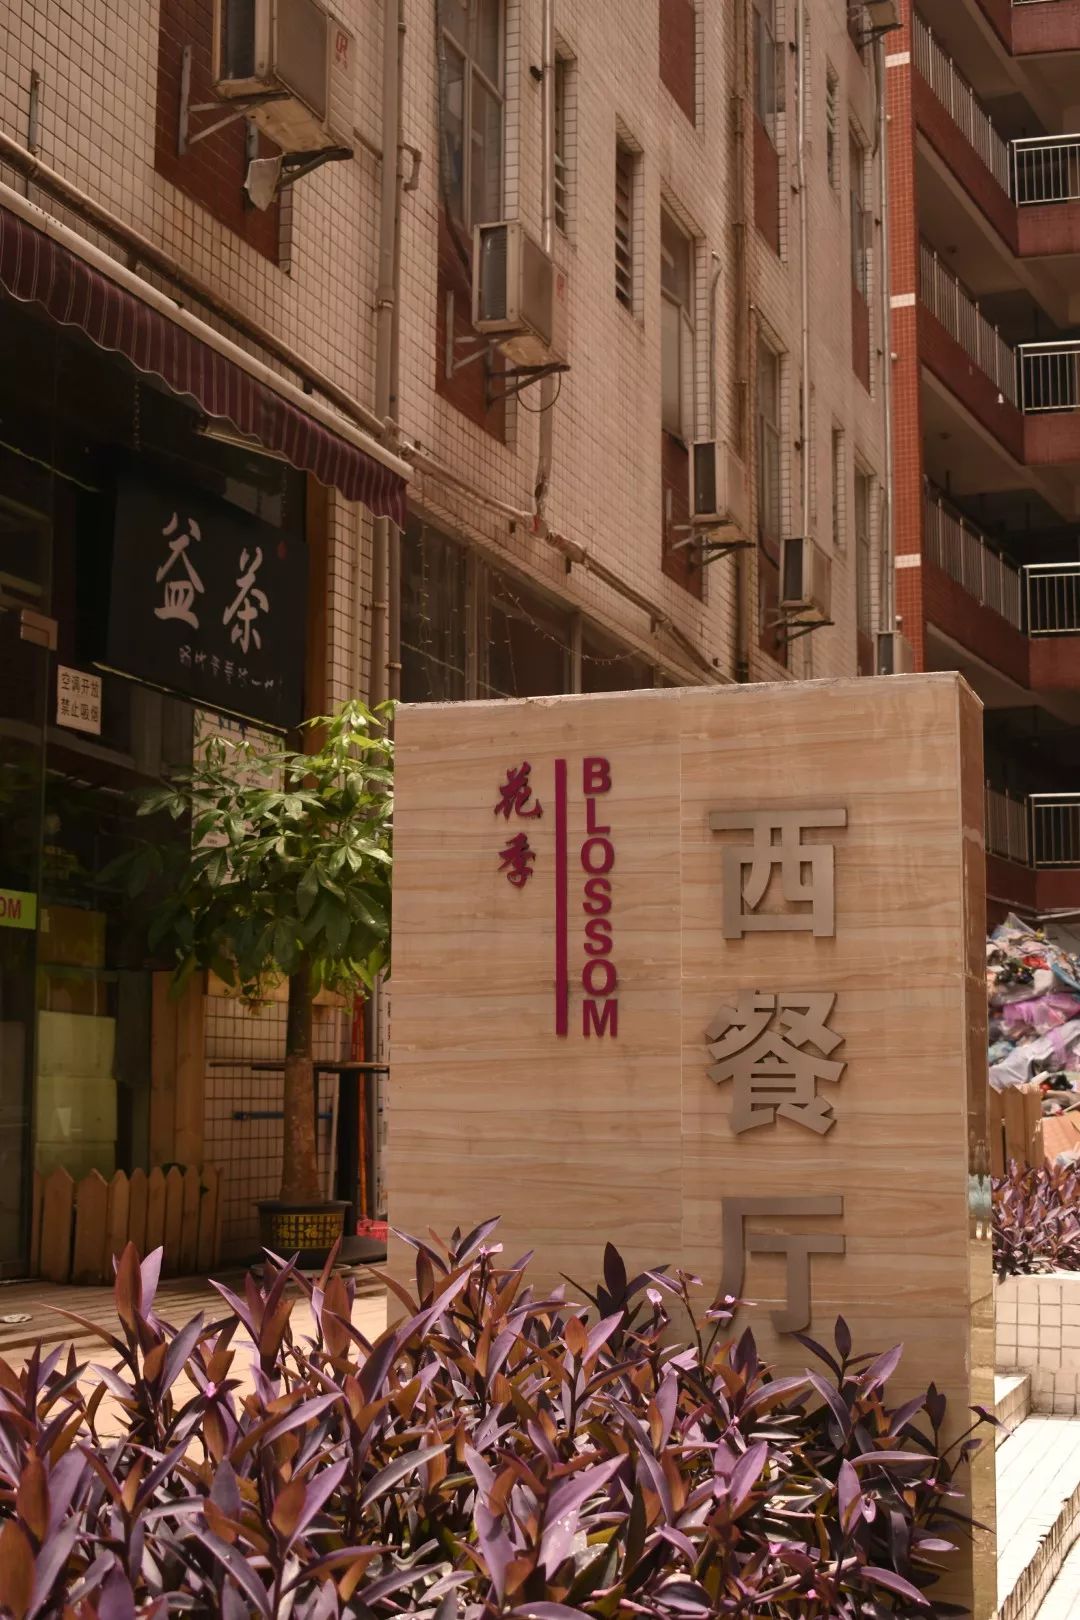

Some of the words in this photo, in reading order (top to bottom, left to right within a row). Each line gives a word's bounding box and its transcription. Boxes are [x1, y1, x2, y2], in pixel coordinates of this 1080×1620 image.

[580, 757, 619, 1038] BLOSSOM
[704, 807, 847, 1334] 西餐厅
